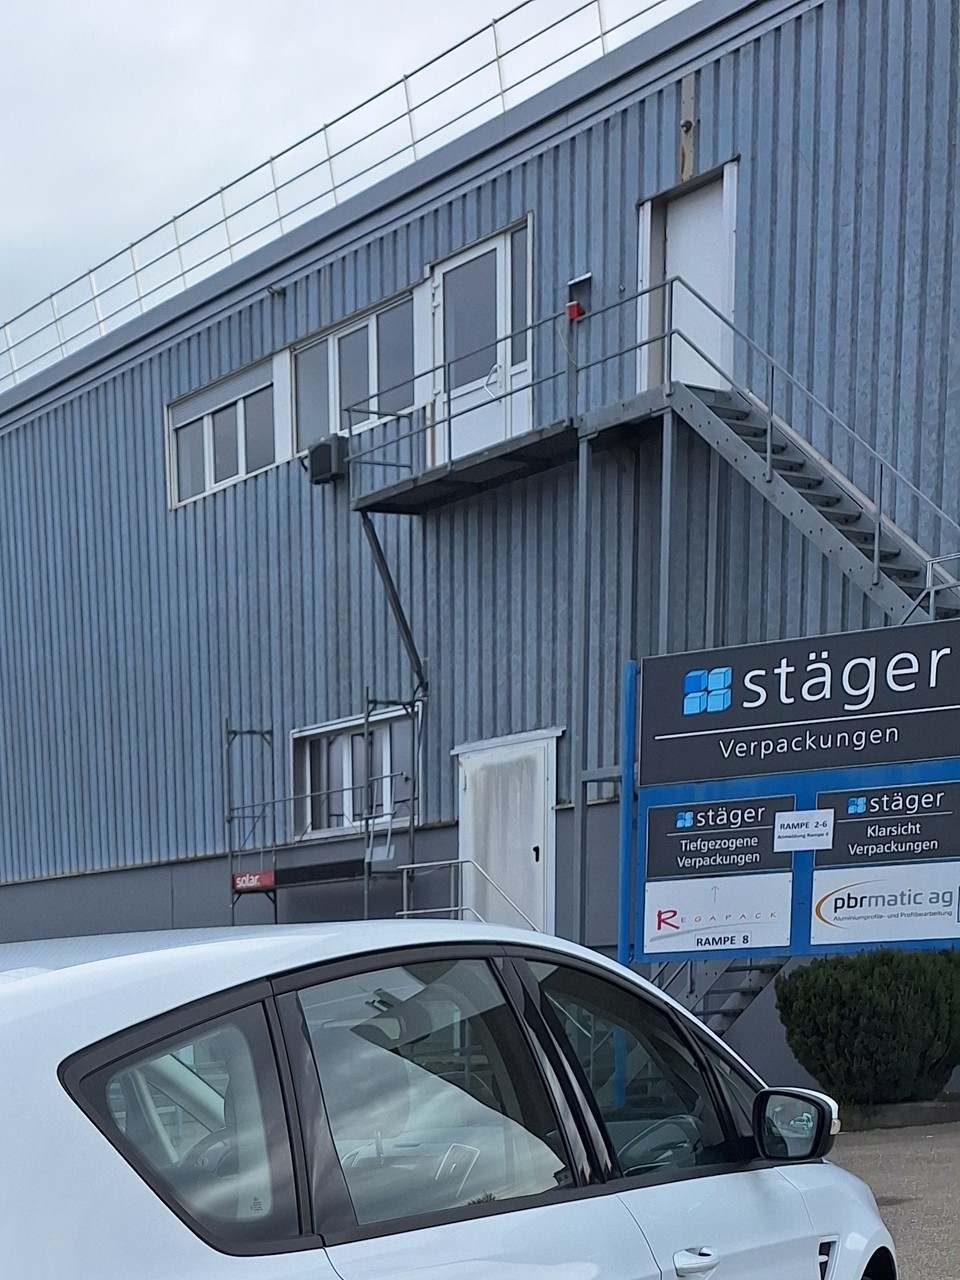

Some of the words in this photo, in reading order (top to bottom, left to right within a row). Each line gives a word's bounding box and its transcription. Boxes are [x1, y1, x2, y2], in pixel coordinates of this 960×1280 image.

[742, 647, 951, 710] stäger
[719, 726, 899, 760] Verpackungen
[866, 791, 945, 814] stäger
[696, 806, 766, 828] stäger
[780, 821, 810, 830] RAMPE
[814, 820, 828, 829] 2-6
[867, 822, 921, 838] Klarsicht
[680, 836, 759, 853] Tiefgezogene
[848, 839, 938, 857] Verpackungen
[677, 852, 760, 869] Verpackungen
[833, 889, 923, 914] pbrmatic
[928, 890, 954, 908] ag
[887, 912, 899, 920] und
[696, 935, 737, 947] RAMPE
[742, 934, 750, 945] 8
